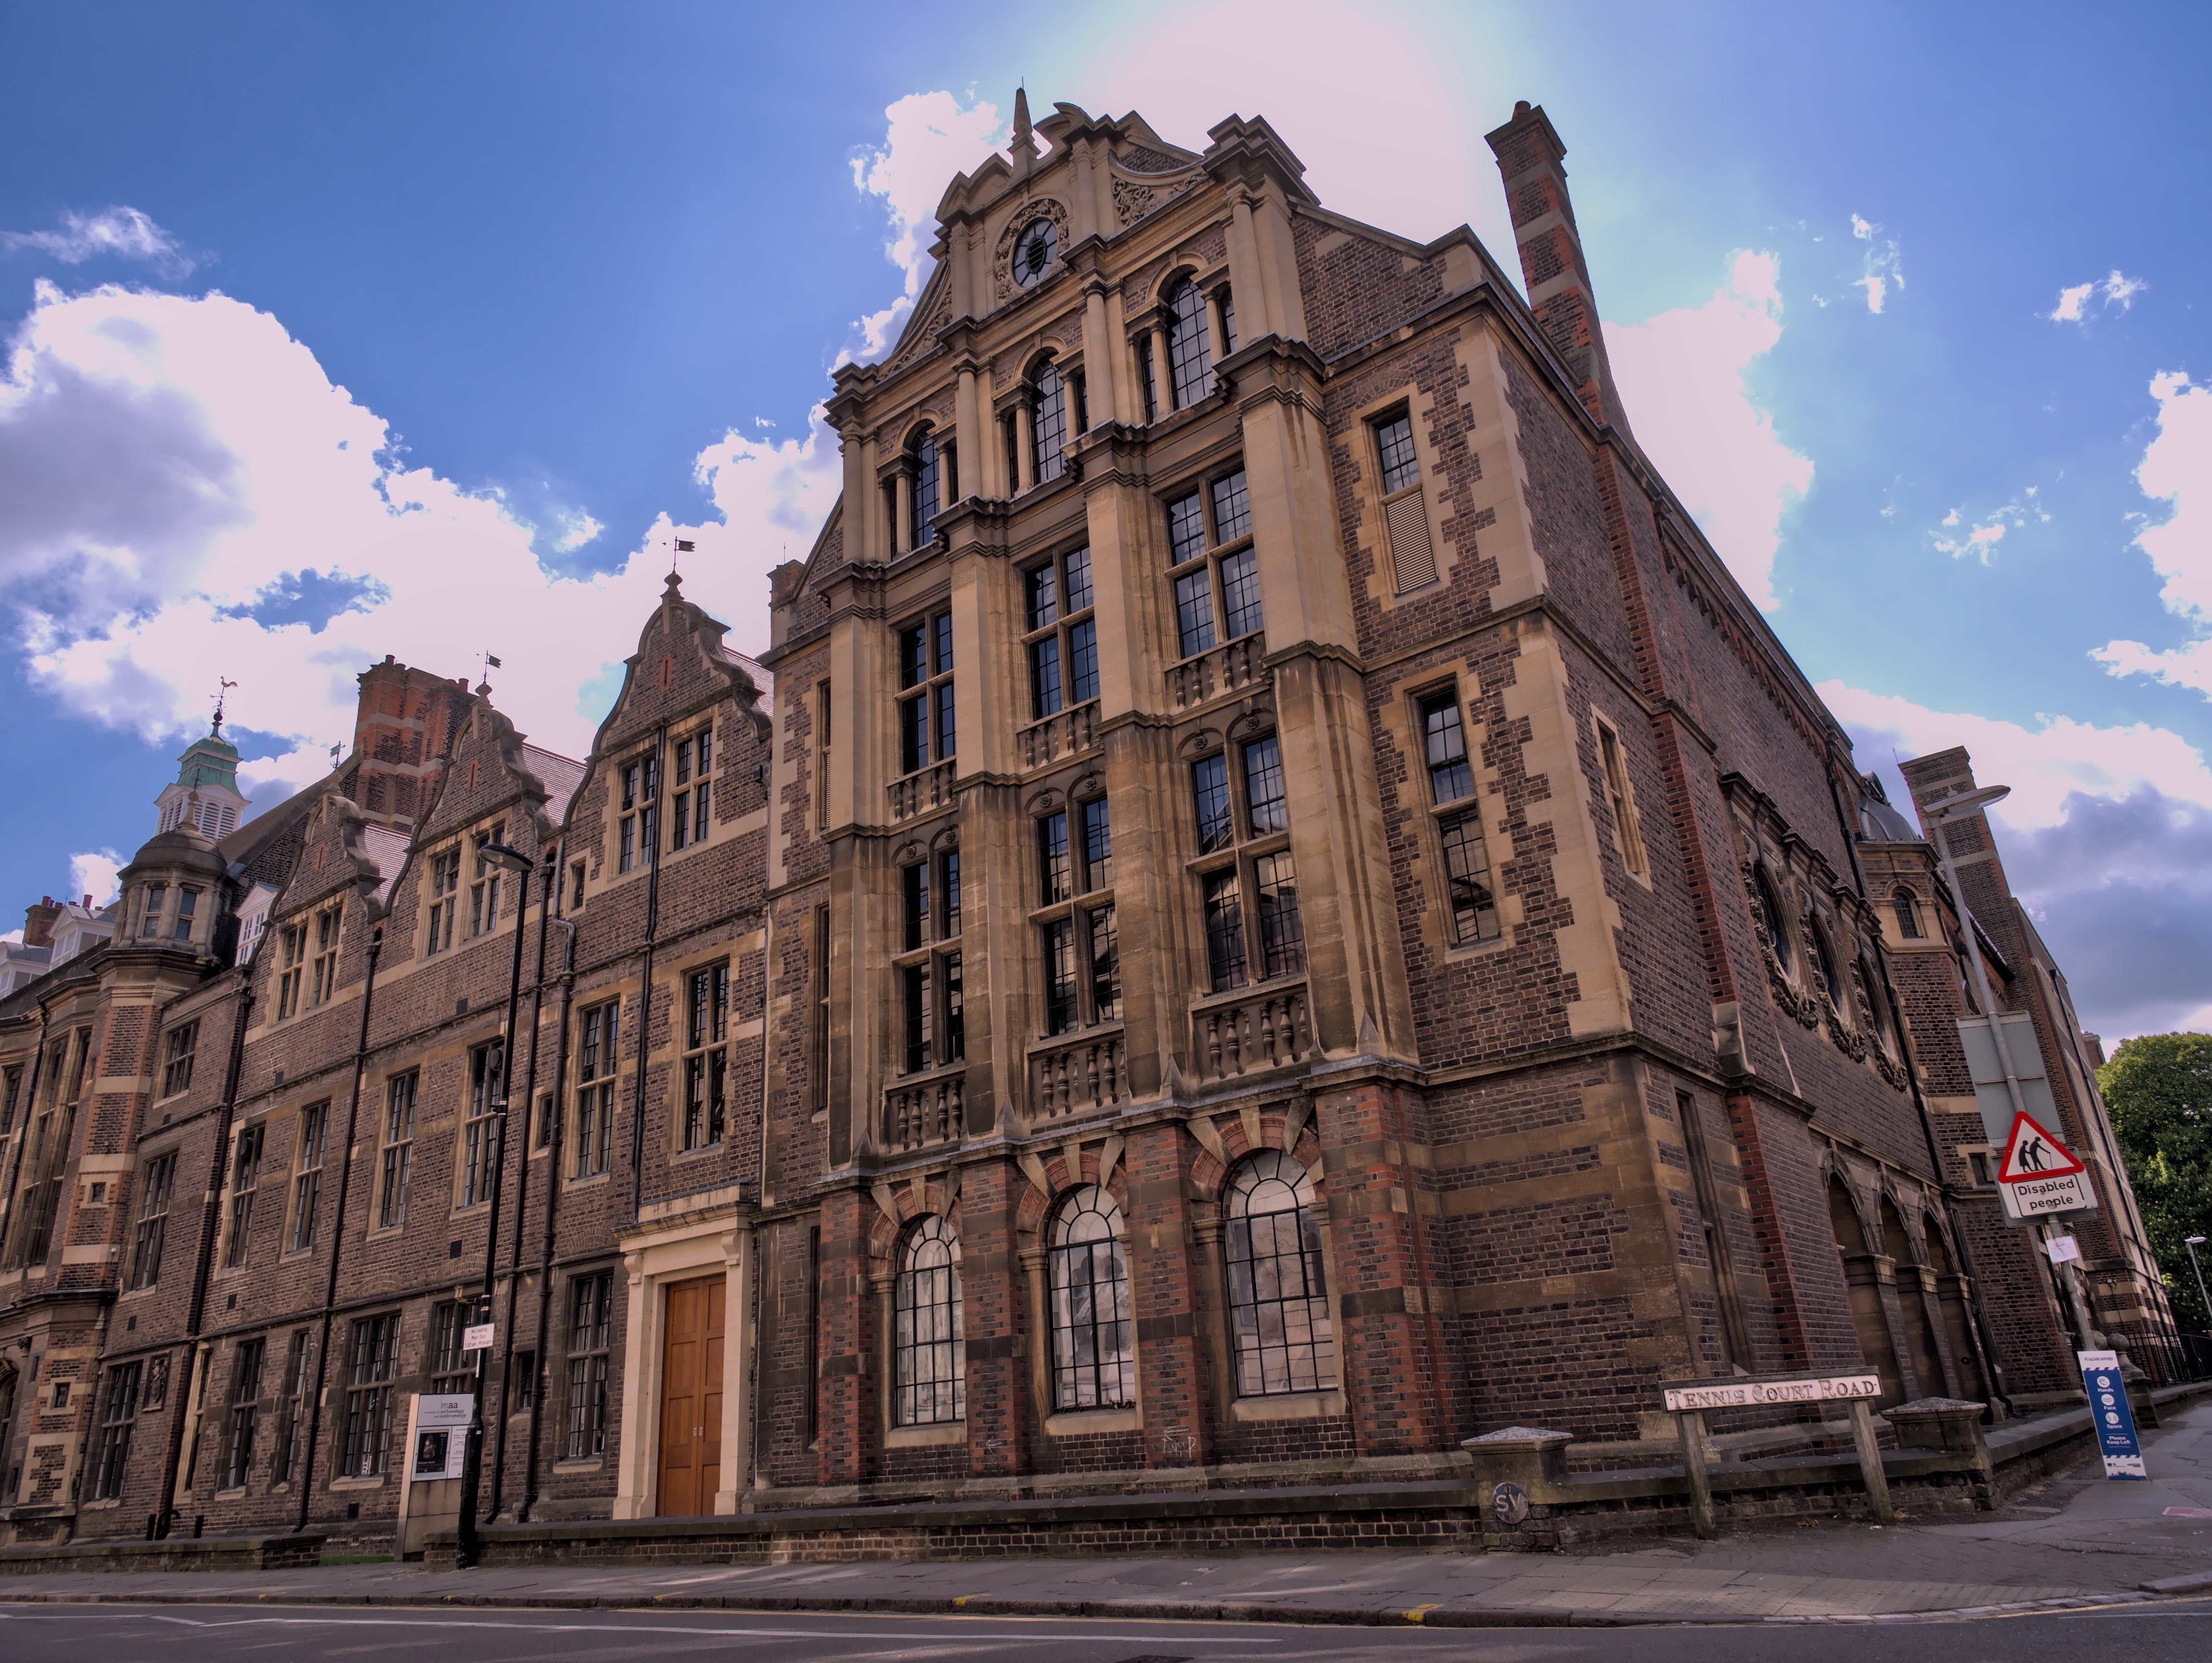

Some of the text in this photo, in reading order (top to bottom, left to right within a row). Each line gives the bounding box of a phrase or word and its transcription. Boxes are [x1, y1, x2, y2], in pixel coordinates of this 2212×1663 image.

[2017, 1178, 2075, 1196] Disabled
[2029, 1195, 2074, 1211] people
[1669, 1380, 1875, 1409] TENNIS COURT ROAD
[1496, 1493, 1522, 1513] SV
